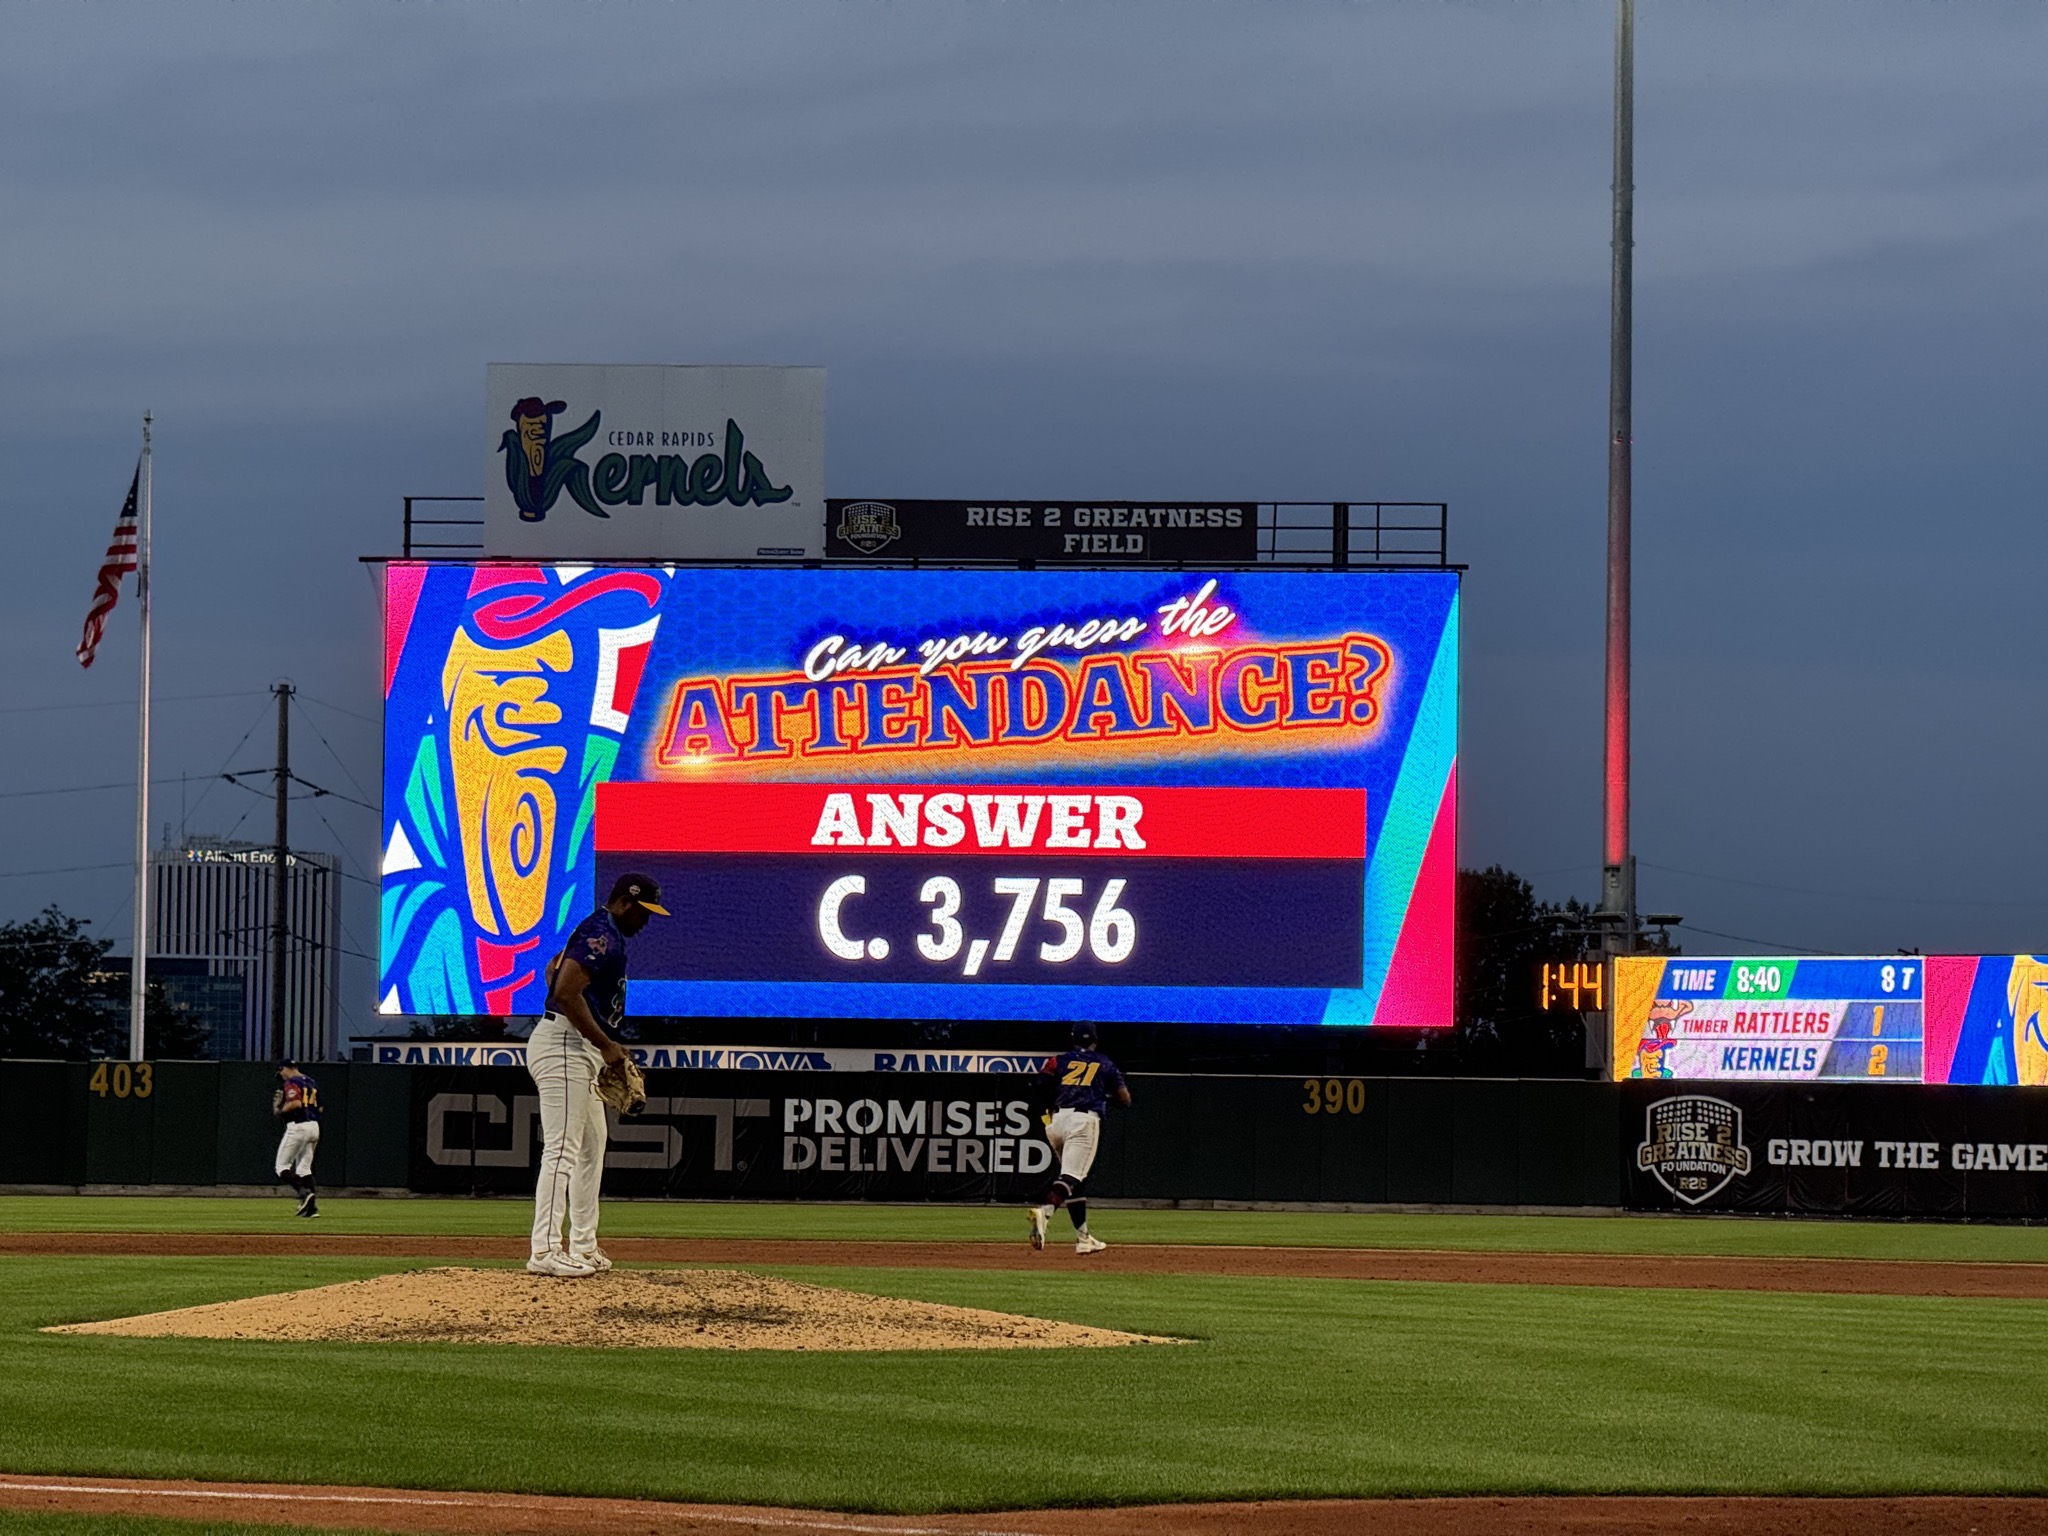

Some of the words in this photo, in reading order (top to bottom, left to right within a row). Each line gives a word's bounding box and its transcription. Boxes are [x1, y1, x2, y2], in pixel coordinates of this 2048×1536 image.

[609, 431, 654, 447] CEDAR
[662, 431, 715, 447] RAPIDS
[498, 408, 793, 520] Kernels
[966, 507, 1031, 527] RISE
[1044, 508, 1061, 527] 2
[1073, 508, 1243, 528] GREATNESS
[1063, 533, 1144, 554] FIELD
[804, 634, 907, 682] Can
[919, 629, 1007, 675] you
[1010, 614, 1147, 670] guess
[1157, 578, 1237, 638] the
[656, 632, 1391, 766] ATTENDANCE?
[811, 792, 1147, 850] ANSWER
[817, 875, 890, 961] C.
[916, 875, 1138, 977] 3,756
[1541, 962, 1603, 1011] 1:44
[1672, 968, 1717, 991] TIME
[1736, 965, 1781, 994] 8:40
[1881, 965, 1896, 993] 8
[1901, 967, 1915, 991] T
[1683, 1019, 1729, 1034] TIMBER
[1733, 1011, 1831, 1035] RATTLERS
[1872, 1005, 1885, 1037] 1
[1061, 1060, 1100, 1087] 21
[1721, 1046, 1818, 1072] KERNELS
[1867, 1044, 1889, 1076] 2
[88, 1062, 154, 1098] 403
[1302, 1079, 1367, 1115] 390
[783, 1098, 1031, 1136] PROMISES
[1656, 1121, 1710, 1144] RISE
[1716, 1125, 1732, 1146] 2
[782, 1136, 1053, 1174] DELIVERED
[1641, 1141, 1748, 1171] GREATNESS
[1660, 1160, 1727, 1175] FOUNDATION
[1767, 1139, 1864, 1167] GROW
[1874, 1141, 1940, 1169] THE
[1951, 1143, 2048, 1172] GAME
[1679, 1177, 1709, 1190] R2G
